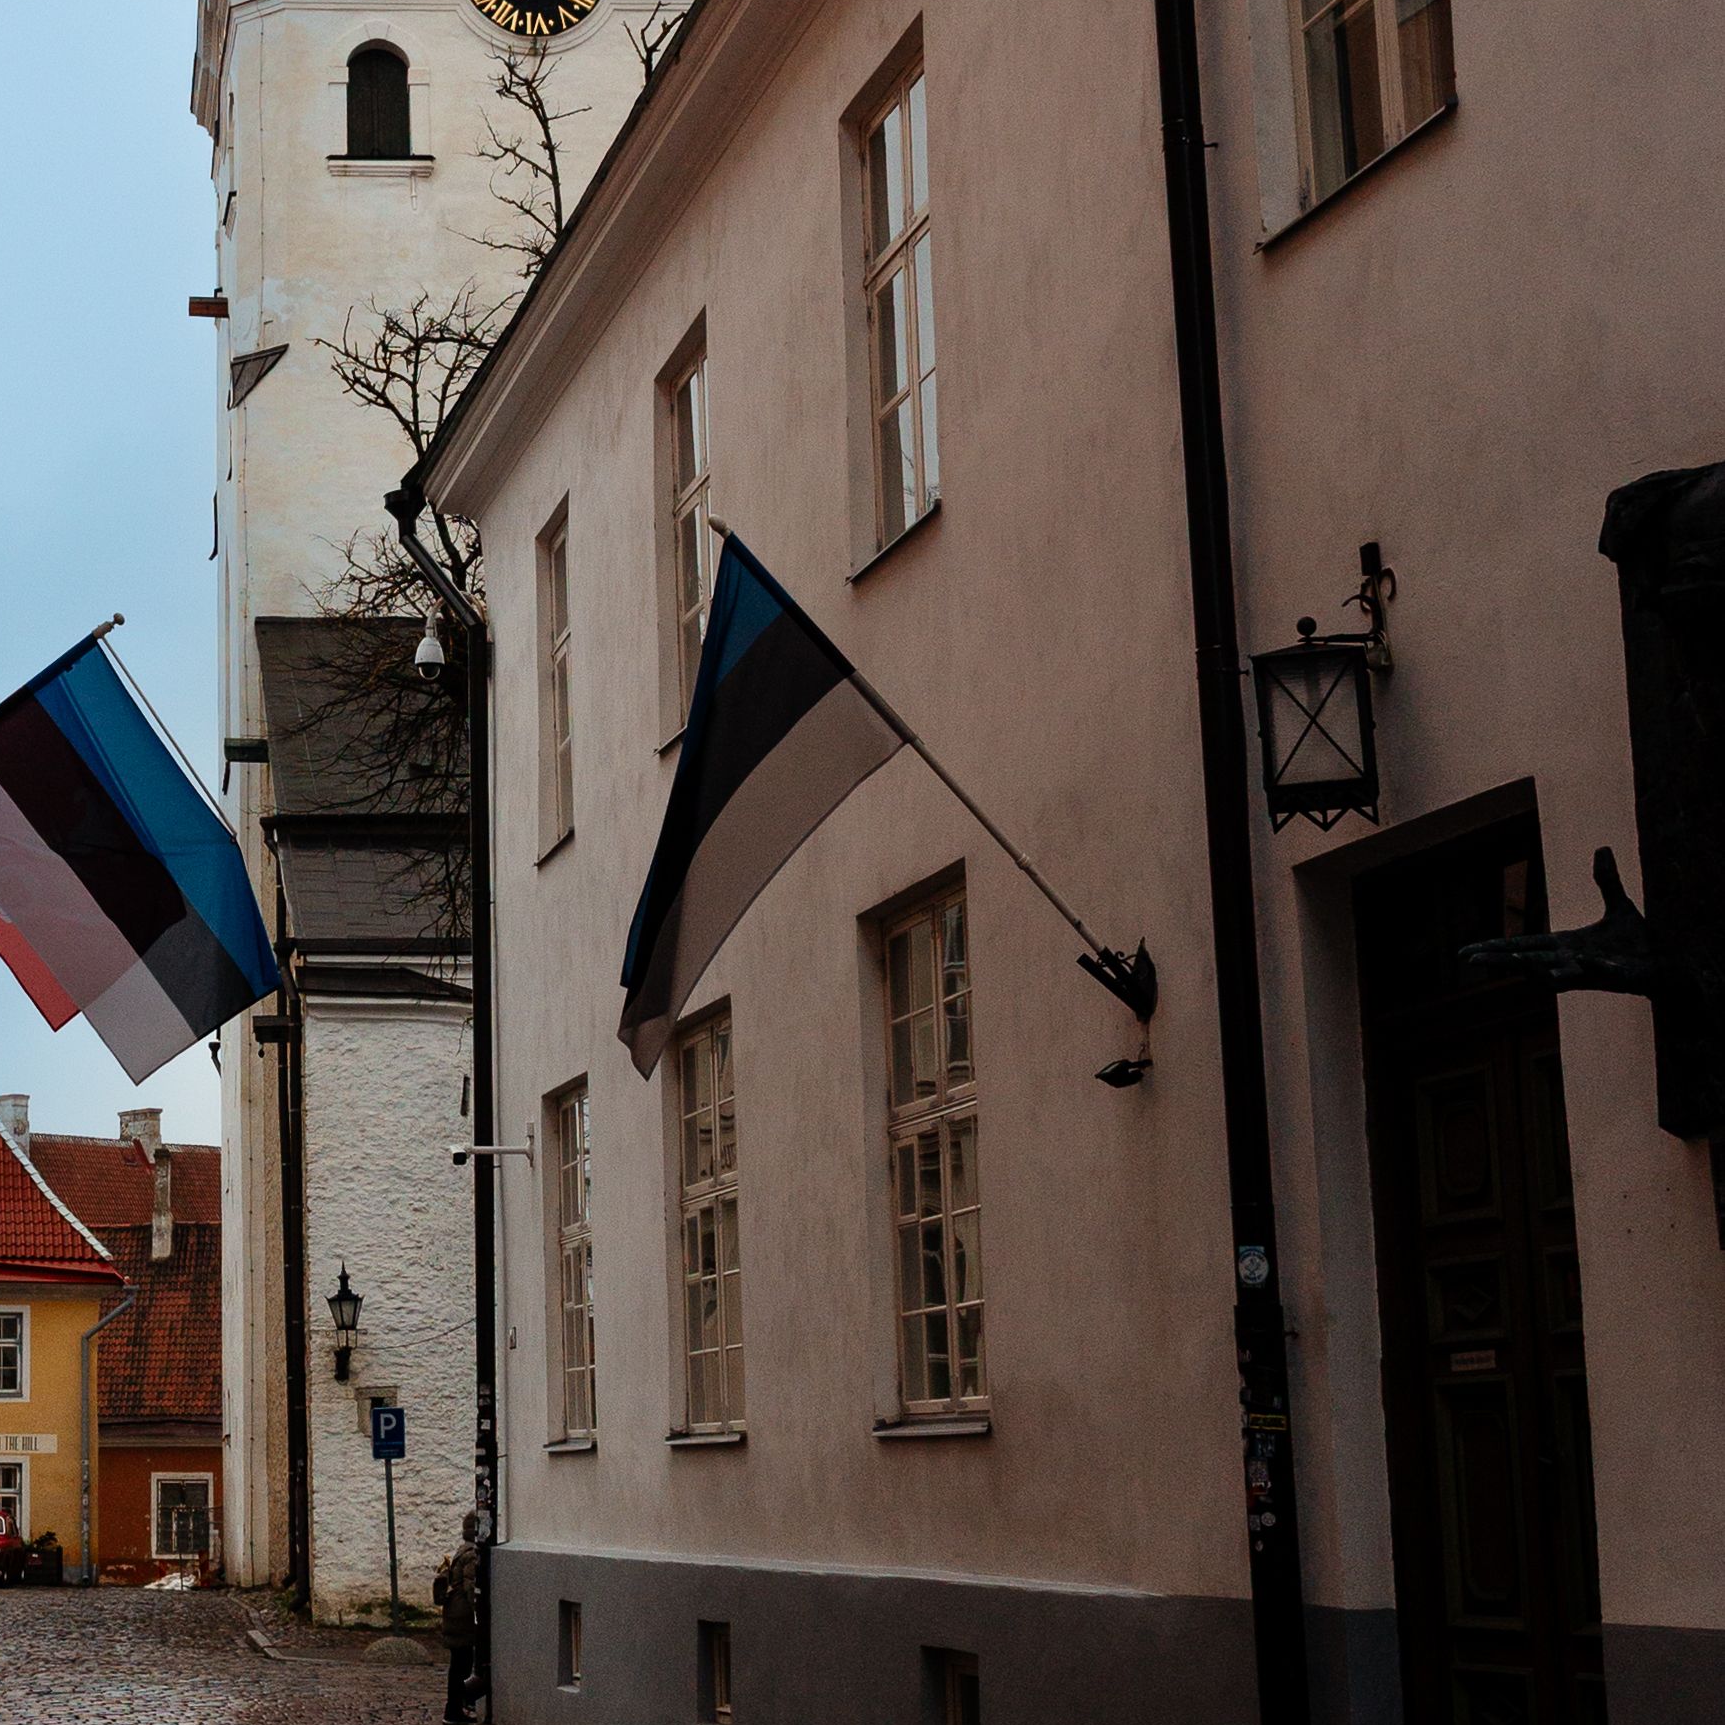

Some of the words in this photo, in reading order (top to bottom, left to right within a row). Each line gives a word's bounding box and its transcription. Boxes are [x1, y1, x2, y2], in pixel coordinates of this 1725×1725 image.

[525, 12, 549, 35] VI
[557, 5, 579, 29] V
[379, 1413, 397, 1439] P
[5, 1436, 19, 1451] THE
[22, 1436, 39, 1451] HILL
